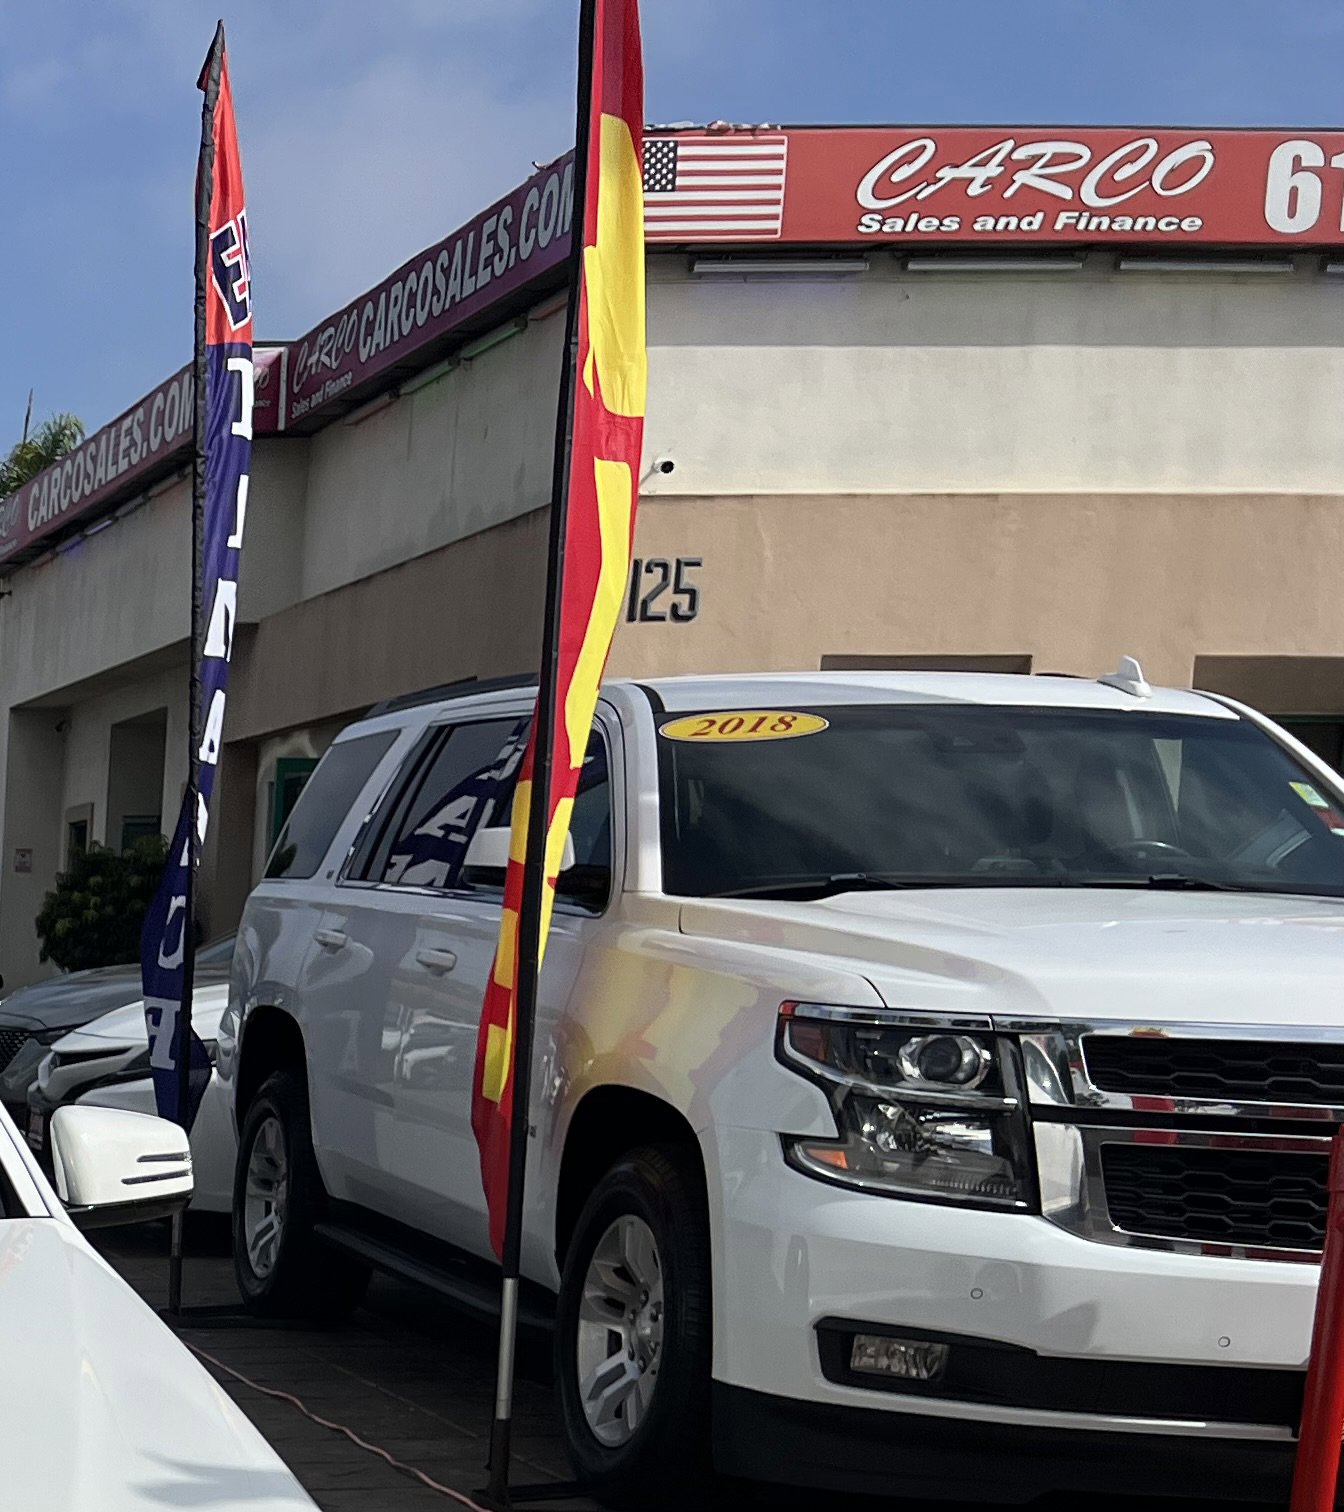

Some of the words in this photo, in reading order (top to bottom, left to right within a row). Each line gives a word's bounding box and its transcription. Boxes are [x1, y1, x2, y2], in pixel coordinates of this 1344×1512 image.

[857, 137, 1215, 210] CARCO
[857, 213, 961, 233] Sales
[972, 211, 1044, 232] and
[1054, 212, 1204, 233] Finance
[293, 309, 358, 394] CARCO
[626, 557, 702, 623] 125
[688, 715, 798, 737] 2018
